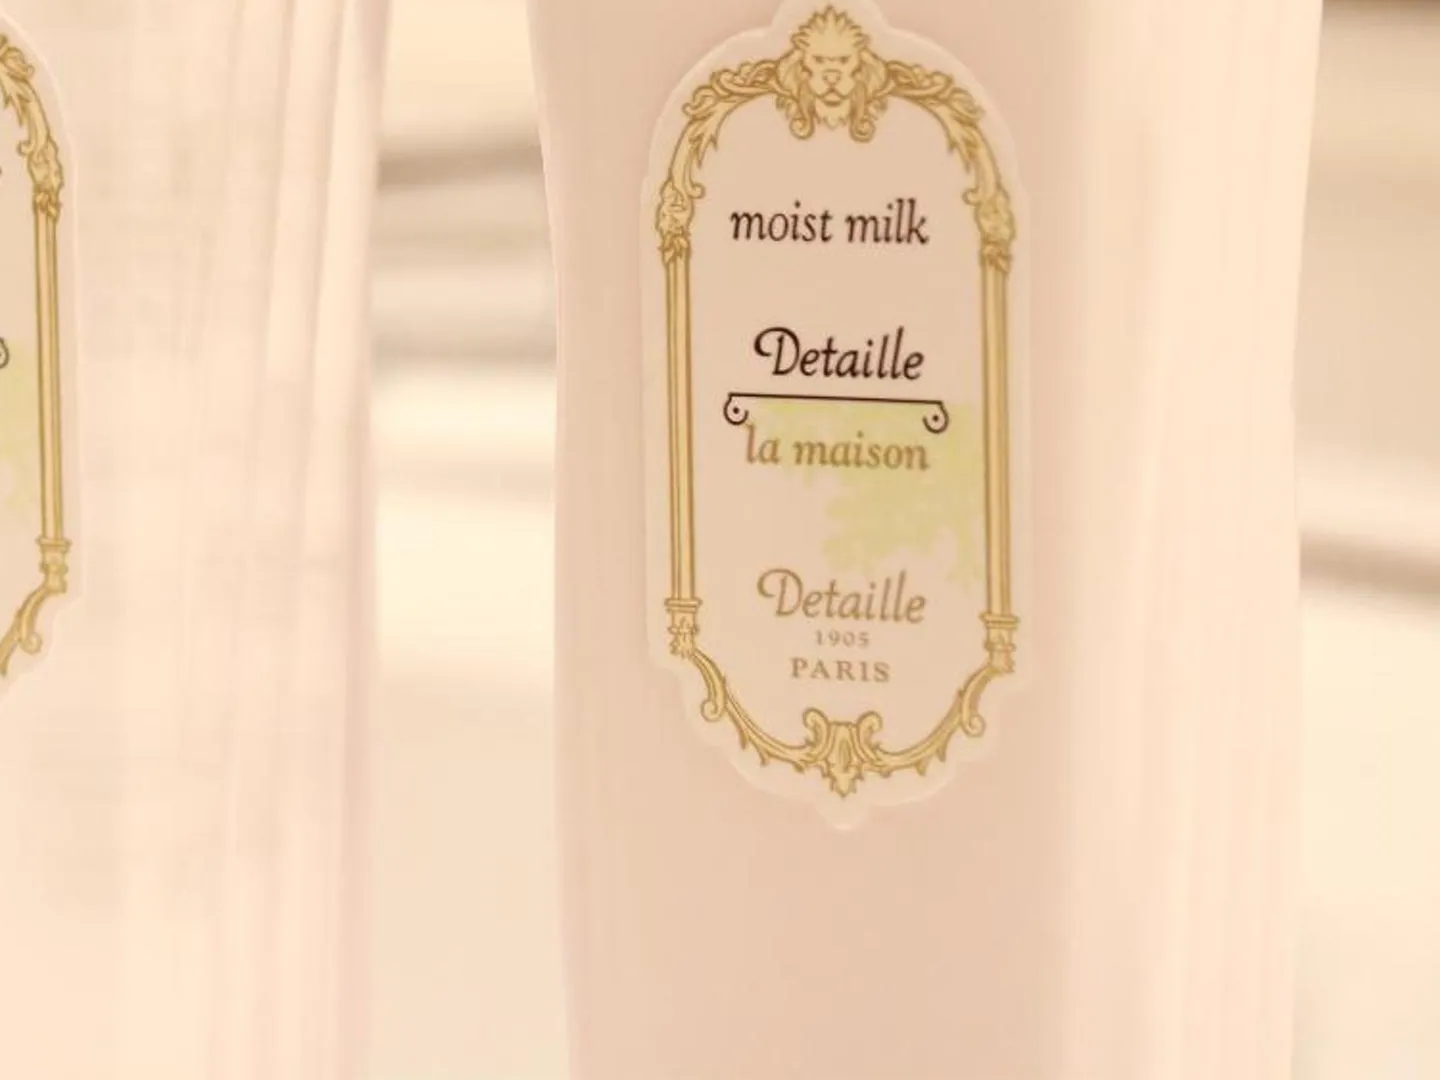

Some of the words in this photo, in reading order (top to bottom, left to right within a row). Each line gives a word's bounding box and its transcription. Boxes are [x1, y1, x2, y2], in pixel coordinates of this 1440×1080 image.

[729, 199, 834, 244] moist
[844, 196, 931, 246] milk
[753, 325, 925, 380] Detaille
[744, 422, 781, 465] la
[791, 430, 930, 471] maison
[756, 568, 927, 624] Detaille
[815, 628, 871, 648] 1905
[791, 657, 891, 684] PARIS
